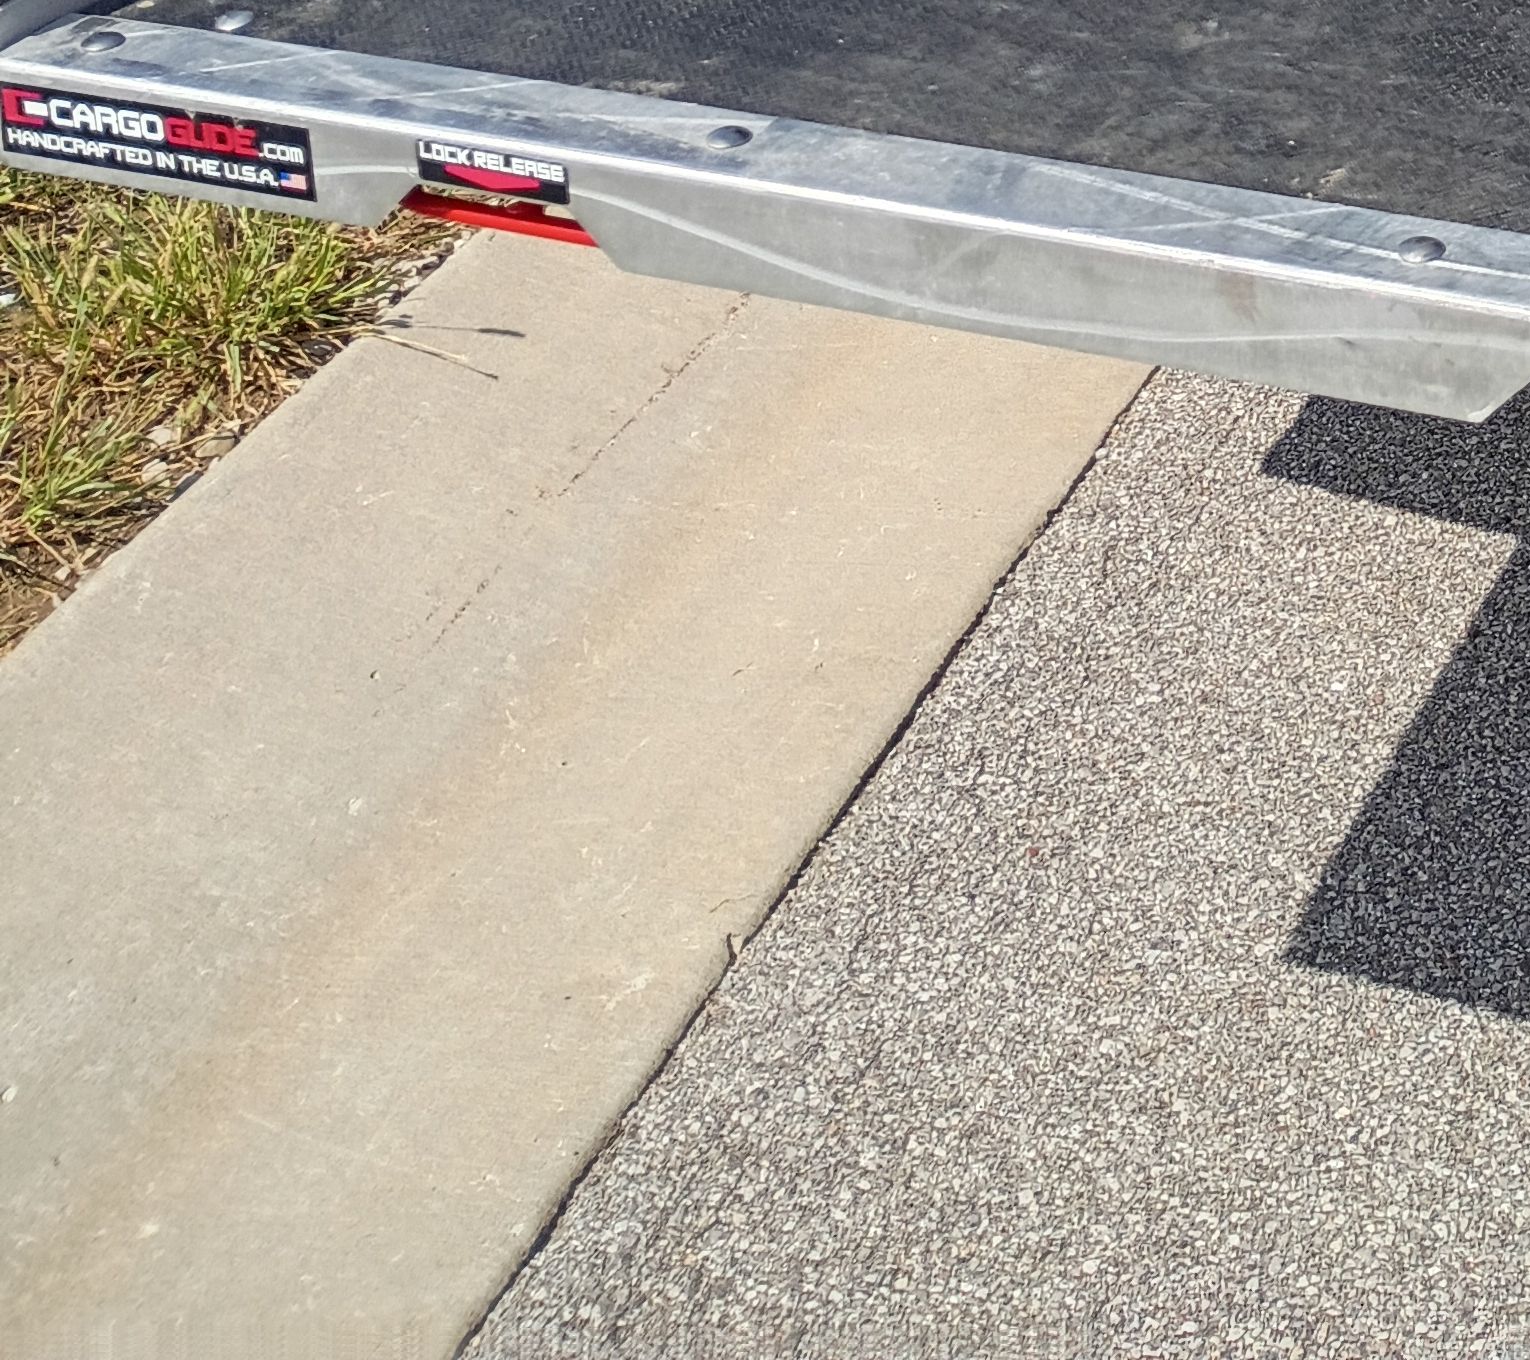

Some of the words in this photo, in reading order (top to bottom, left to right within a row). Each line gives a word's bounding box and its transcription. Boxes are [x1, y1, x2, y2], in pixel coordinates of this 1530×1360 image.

[8, 126, 153, 166] HANDCRAFTED
[156, 150, 176, 171] IN
[177, 154, 221, 178] THE
[418, 140, 471, 166] LOCK
[472, 150, 566, 183] RELEASE
